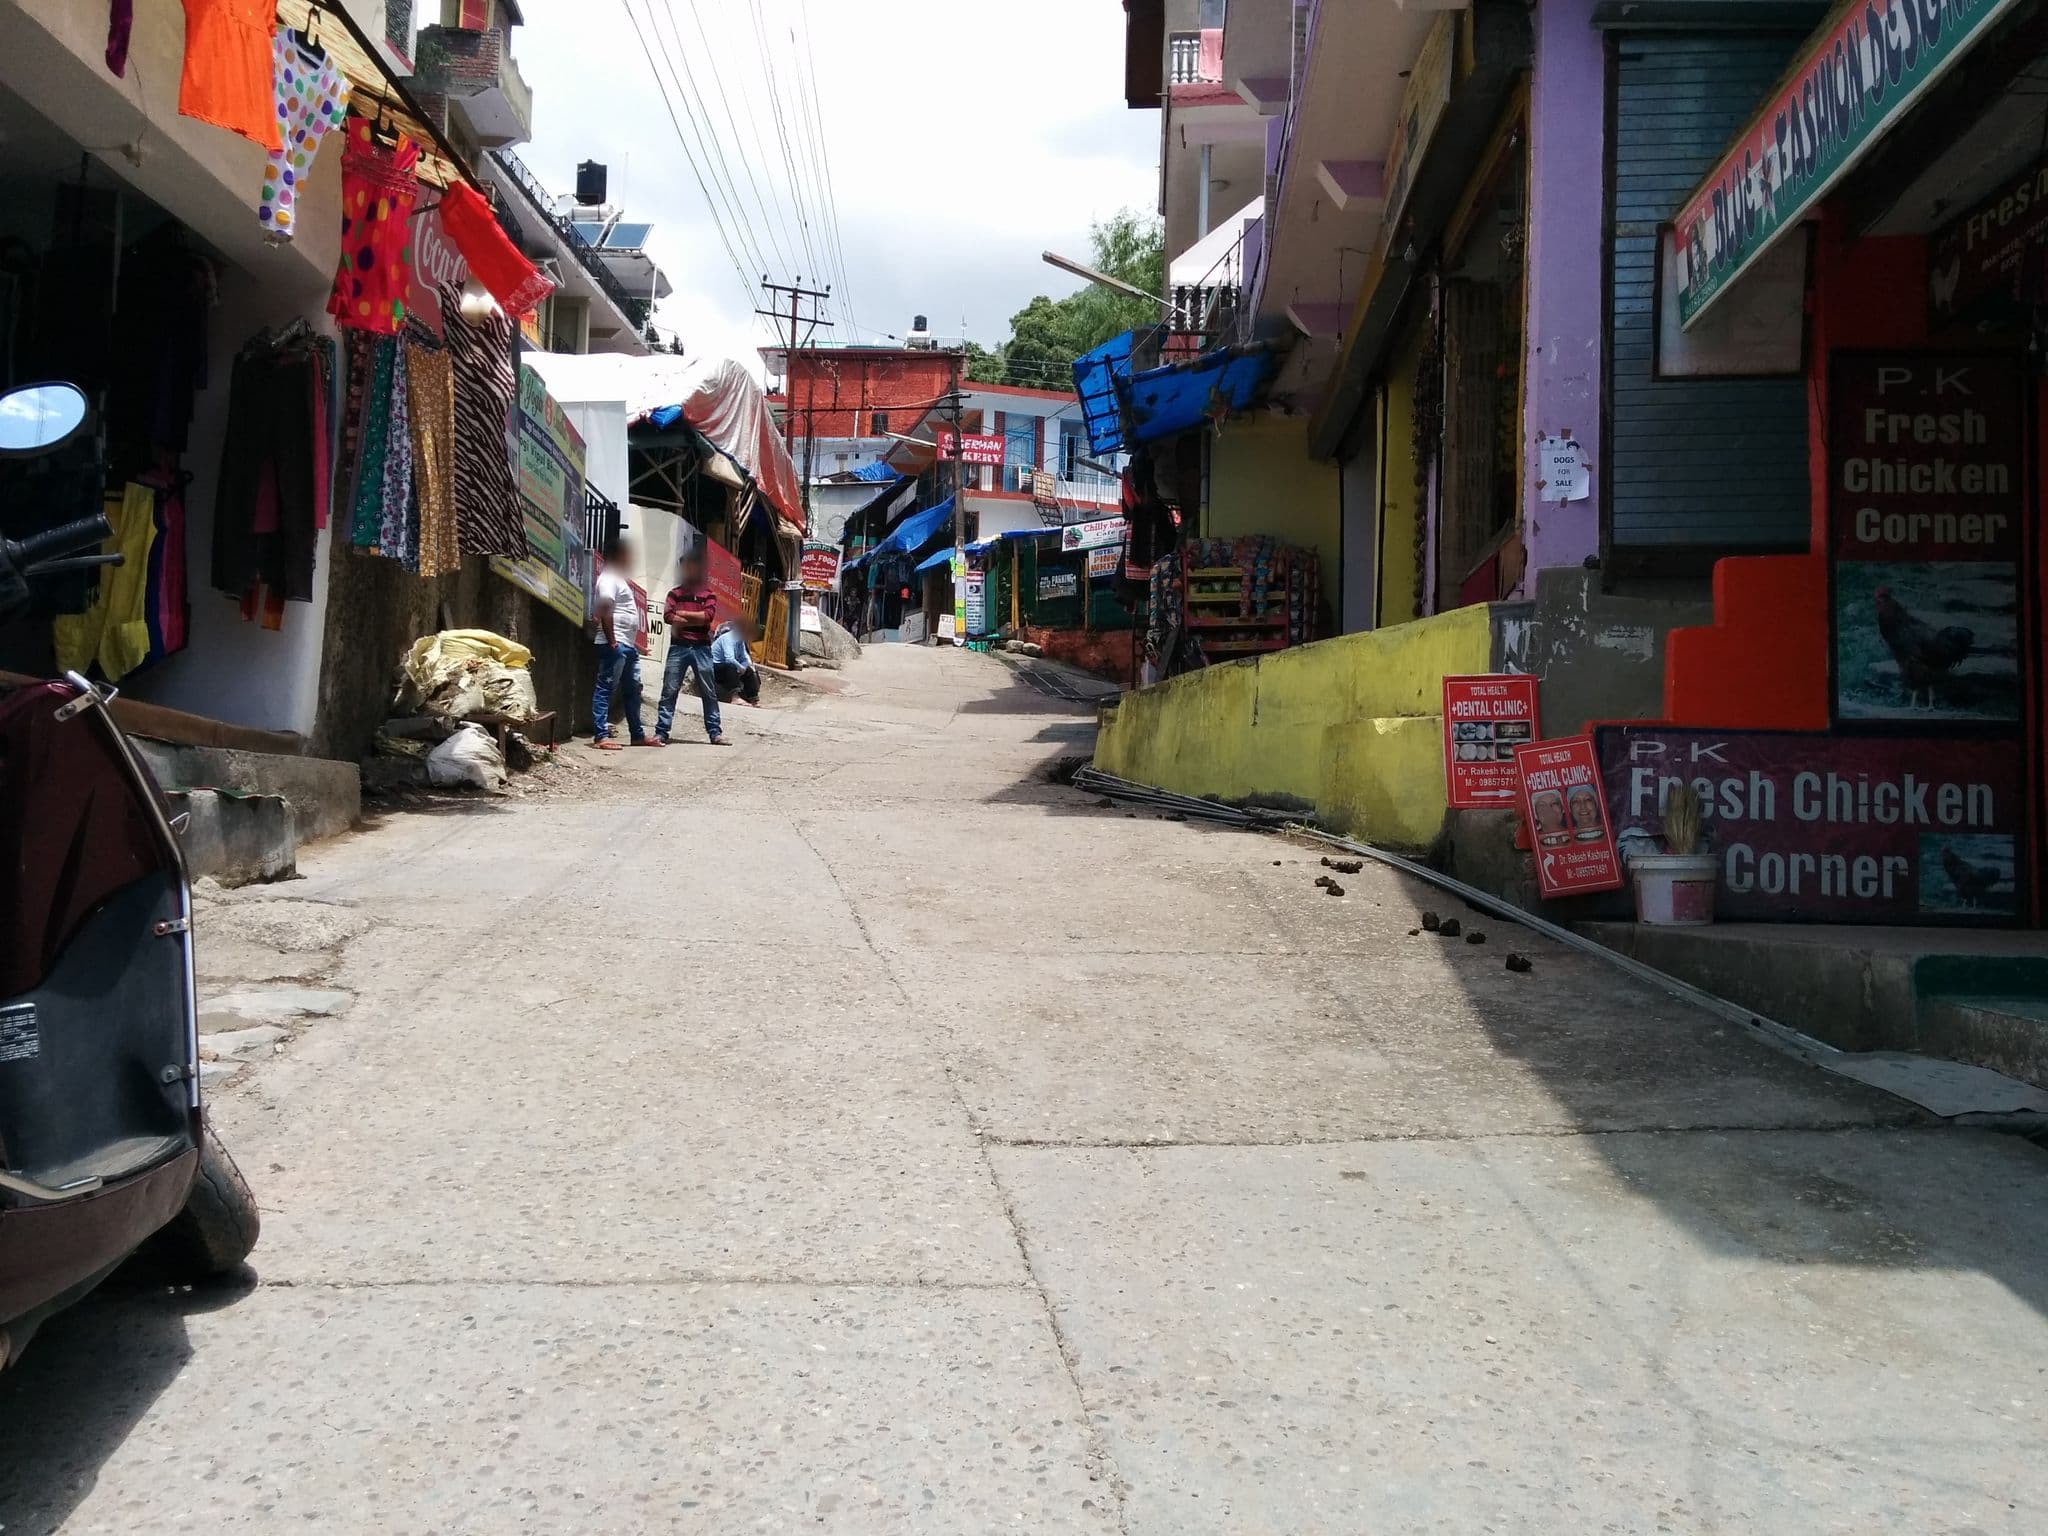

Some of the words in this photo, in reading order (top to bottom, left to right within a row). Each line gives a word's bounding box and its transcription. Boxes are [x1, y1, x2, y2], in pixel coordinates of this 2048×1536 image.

[1775, 15, 1866, 207] FASHION
[1864, 407, 1987, 445] Fresh
[1553, 456, 1575, 464] DOGS
[1843, 456, 2009, 495] Chicken
[1083, 521, 1109, 532] Chilly
[1855, 507, 2008, 545] Corner
[1094, 547, 1114, 556] HOTEL
[818, 555, 837, 566] FOOD
[1090, 561, 1116, 572] WHIT
[1470, 687, 1487, 696] TOTAL
[1487, 686, 1508, 696] HEALTH
[1456, 700, 1492, 717] DENTAL
[1493, 700, 1524, 716] CLINIC
[1539, 752, 1555, 765] TOTAL
[1553, 750, 1572, 763] HEALTH
[1470, 766, 1499, 776] Rakesh
[1530, 769, 1562, 791] DENTAL
[1561, 764, 1588, 786] CLINIC
[1630, 767, 1776, 823] Fresh
[1792, 770, 1995, 828] Chicken
[1724, 841, 1910, 899] Corner
